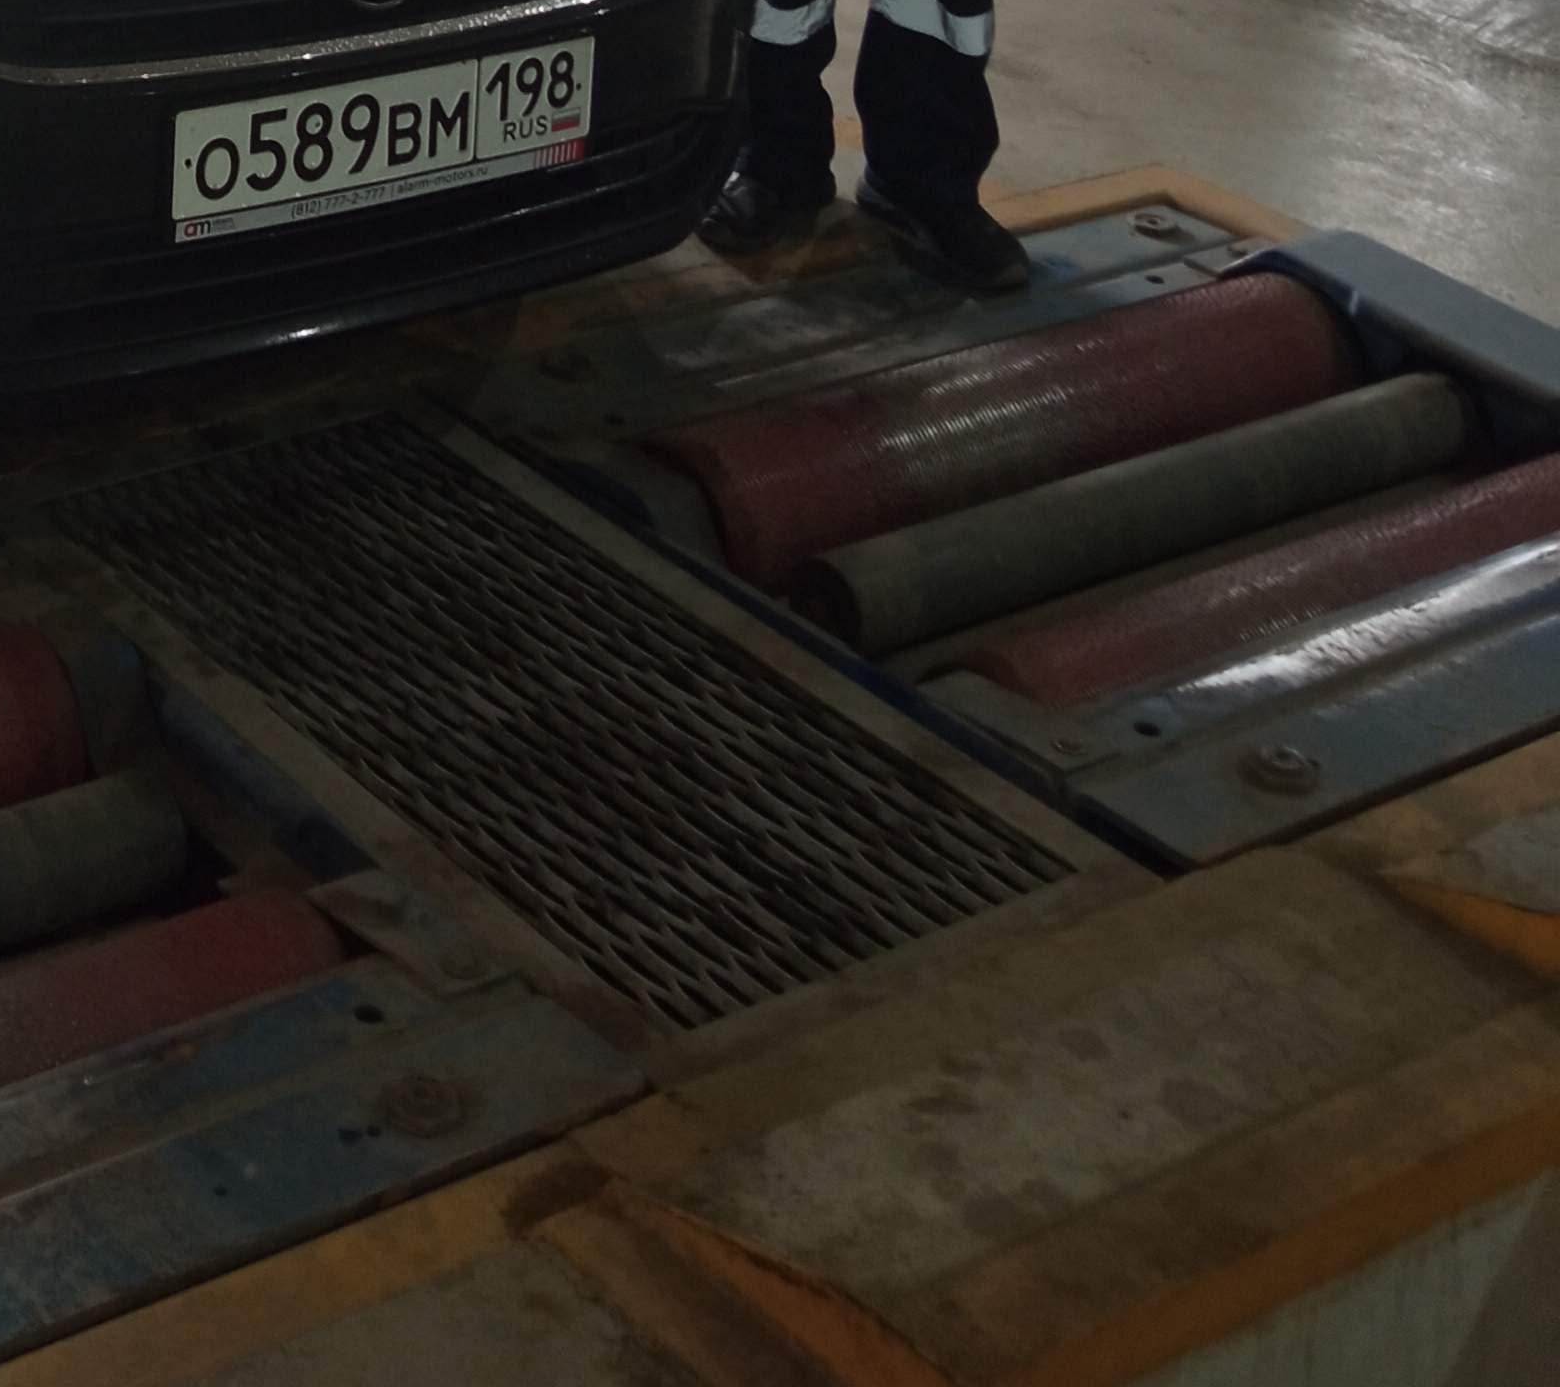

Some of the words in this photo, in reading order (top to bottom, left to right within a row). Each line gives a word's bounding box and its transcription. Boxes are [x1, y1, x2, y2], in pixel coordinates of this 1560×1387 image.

[485, 50, 574, 122] 198
[503, 115, 548, 142] RUS
[291, 200, 322, 219] (812)
[325, 186, 385, 210] 777-2-777
